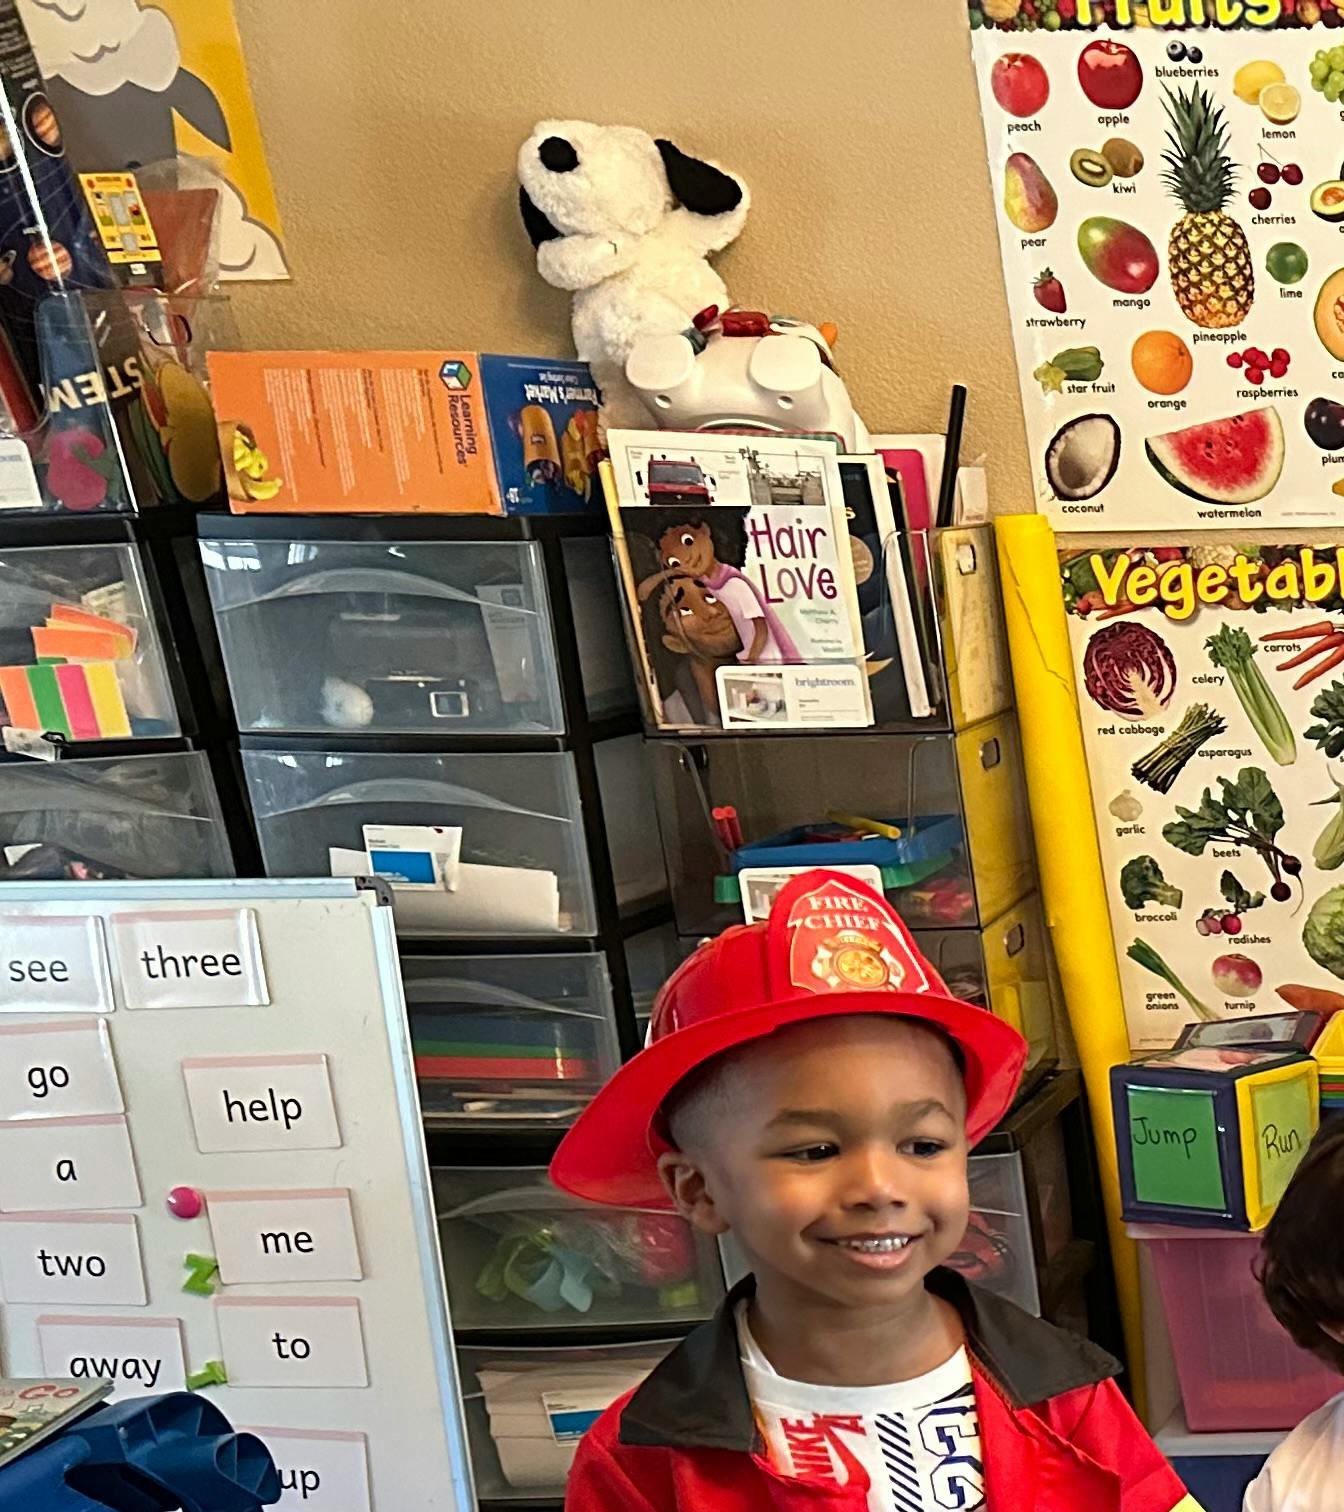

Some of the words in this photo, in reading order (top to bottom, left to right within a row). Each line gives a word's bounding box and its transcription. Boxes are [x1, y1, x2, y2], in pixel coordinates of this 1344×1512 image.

[1155, 66, 1219, 77] blueberries
[1008, 120, 1041, 134] peach
[1098, 113, 1129, 127] apple
[1262, 128, 1296, 139] lemon
[1113, 183, 1136, 193] kiwi
[1252, 214, 1296, 224] cherries
[1113, 299, 1150, 310] mango
[1026, 316, 1086, 329] strawberry
[1193, 331, 1246, 344] pineapple
[39, 356, 143, 412] STEM
[1068, 385, 1087, 393] star
[1092, 383, 1115, 392] fruit
[1237, 387, 1298, 400] raspberries
[1148, 400, 1186, 410] orange
[448, 395, 466, 464] Resources
[460, 395, 477, 454] Learning
[1062, 504, 1104, 513] coconut
[1197, 507, 1261, 518] watermelon
[750, 513, 826, 559] Hair
[759, 564, 837, 604] Love
[1192, 674, 1224, 686] celery
[1098, 725, 1115, 735] red
[1119, 724, 1164, 736] cabbage
[1198, 749, 1252, 759] asparagus
[1116, 824, 1145, 837] garlic
[1213, 848, 1241, 857] beets
[809, 896, 868, 911] FIRE
[804, 914, 880, 931] CHIEF
[1135, 912, 1177, 922] broccoli
[1229, 935, 1271, 944] radishes
[141, 945, 241, 978] three
[9, 961, 68, 982] see
[1225, 1002, 1255, 1011] turnip
[28, 1066, 69, 1097] go
[223, 1088, 301, 1129] help
[1133, 1117, 1196, 1158] Jump
[1262, 1124, 1299, 1159] Run
[57, 1160, 77, 1181] a
[261, 1232, 313, 1253] me
[38, 1250, 105, 1276] two
[272, 1333, 310, 1358] to
[71, 1358, 161, 1387] away
[273, 1462, 320, 1499] up
